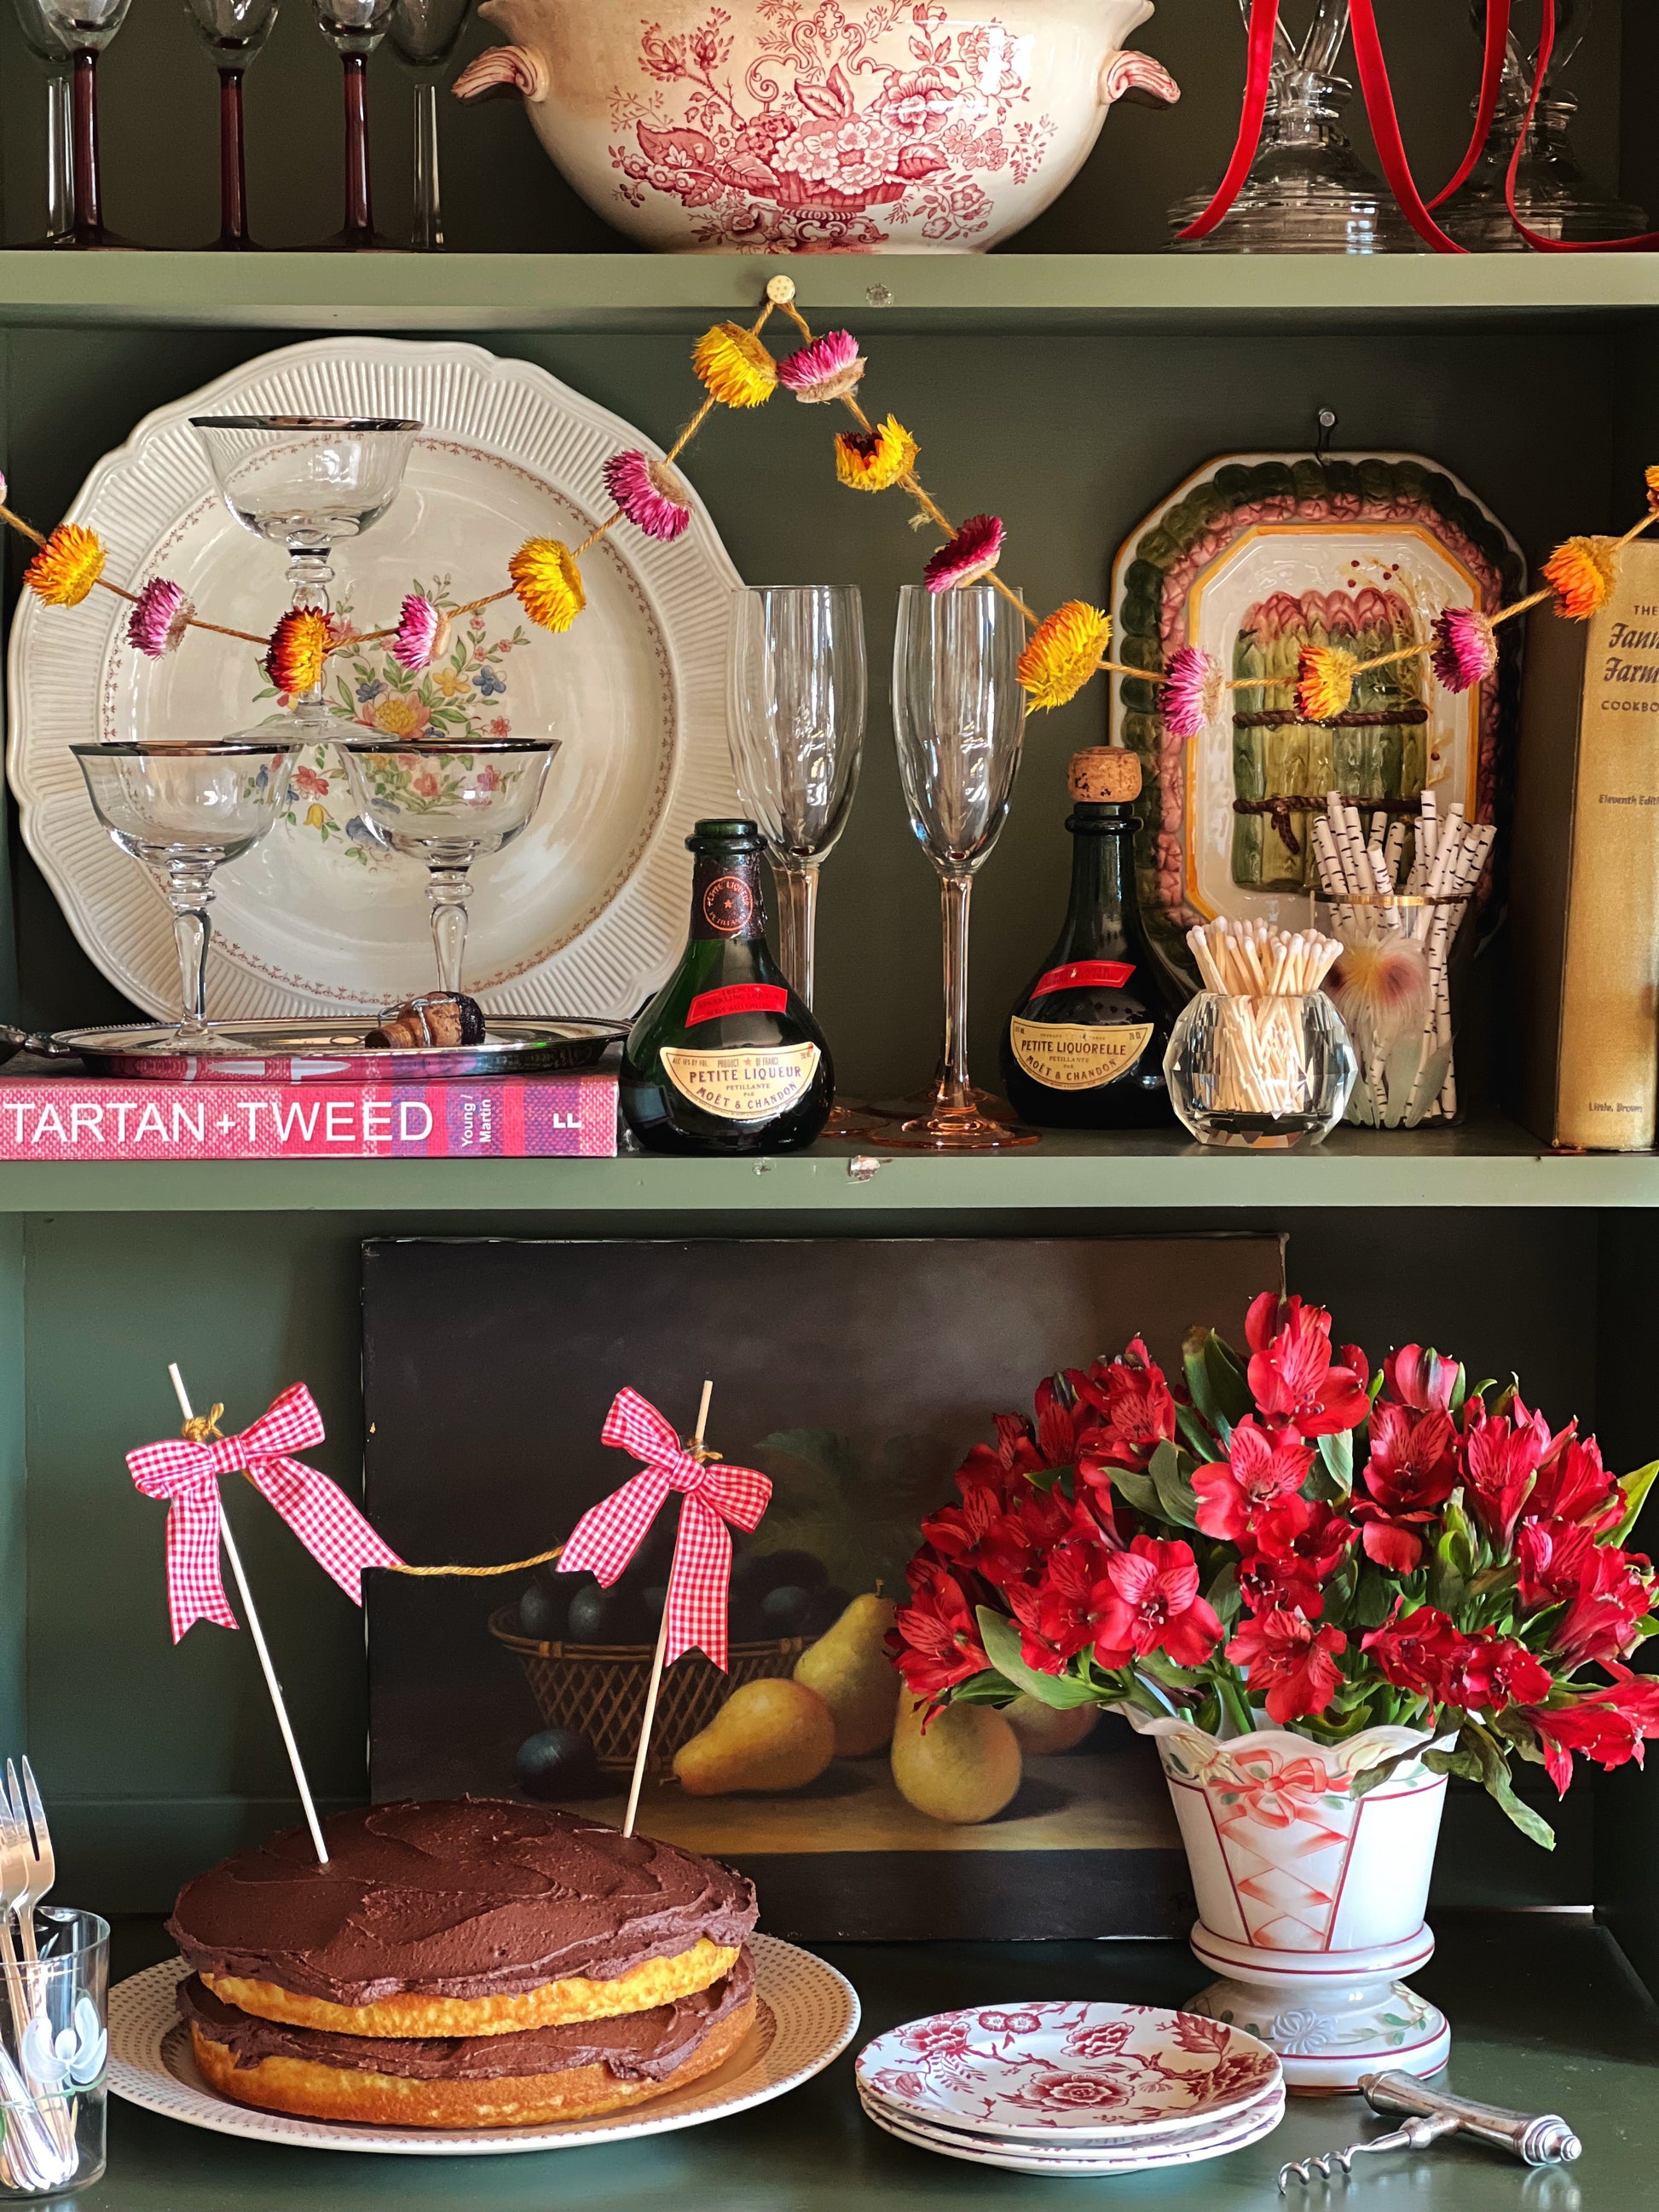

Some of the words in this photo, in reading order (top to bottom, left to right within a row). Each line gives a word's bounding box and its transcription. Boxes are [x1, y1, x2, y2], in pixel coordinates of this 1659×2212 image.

[1633, 604, 1658, 615] THE
[1020, 1039, 1054, 1052] PETITE
[1056, 1041, 1127, 1056] LIQUORELLE
[689, 1069, 739, 1084] PETITE
[744, 1066, 801, 1081] LIQUEUR
[1055, 1071, 1061, 1080] &
[1066, 1058, 1118, 1082] CHANDON
[725, 1083, 771, 1091] PETILLANTE
[734, 1100, 742, 1110] &
[747, 1083, 798, 1110] CHANDON
[460, 1100, 477, 1148] Young
[479, 1098, 492, 1144] Martin
